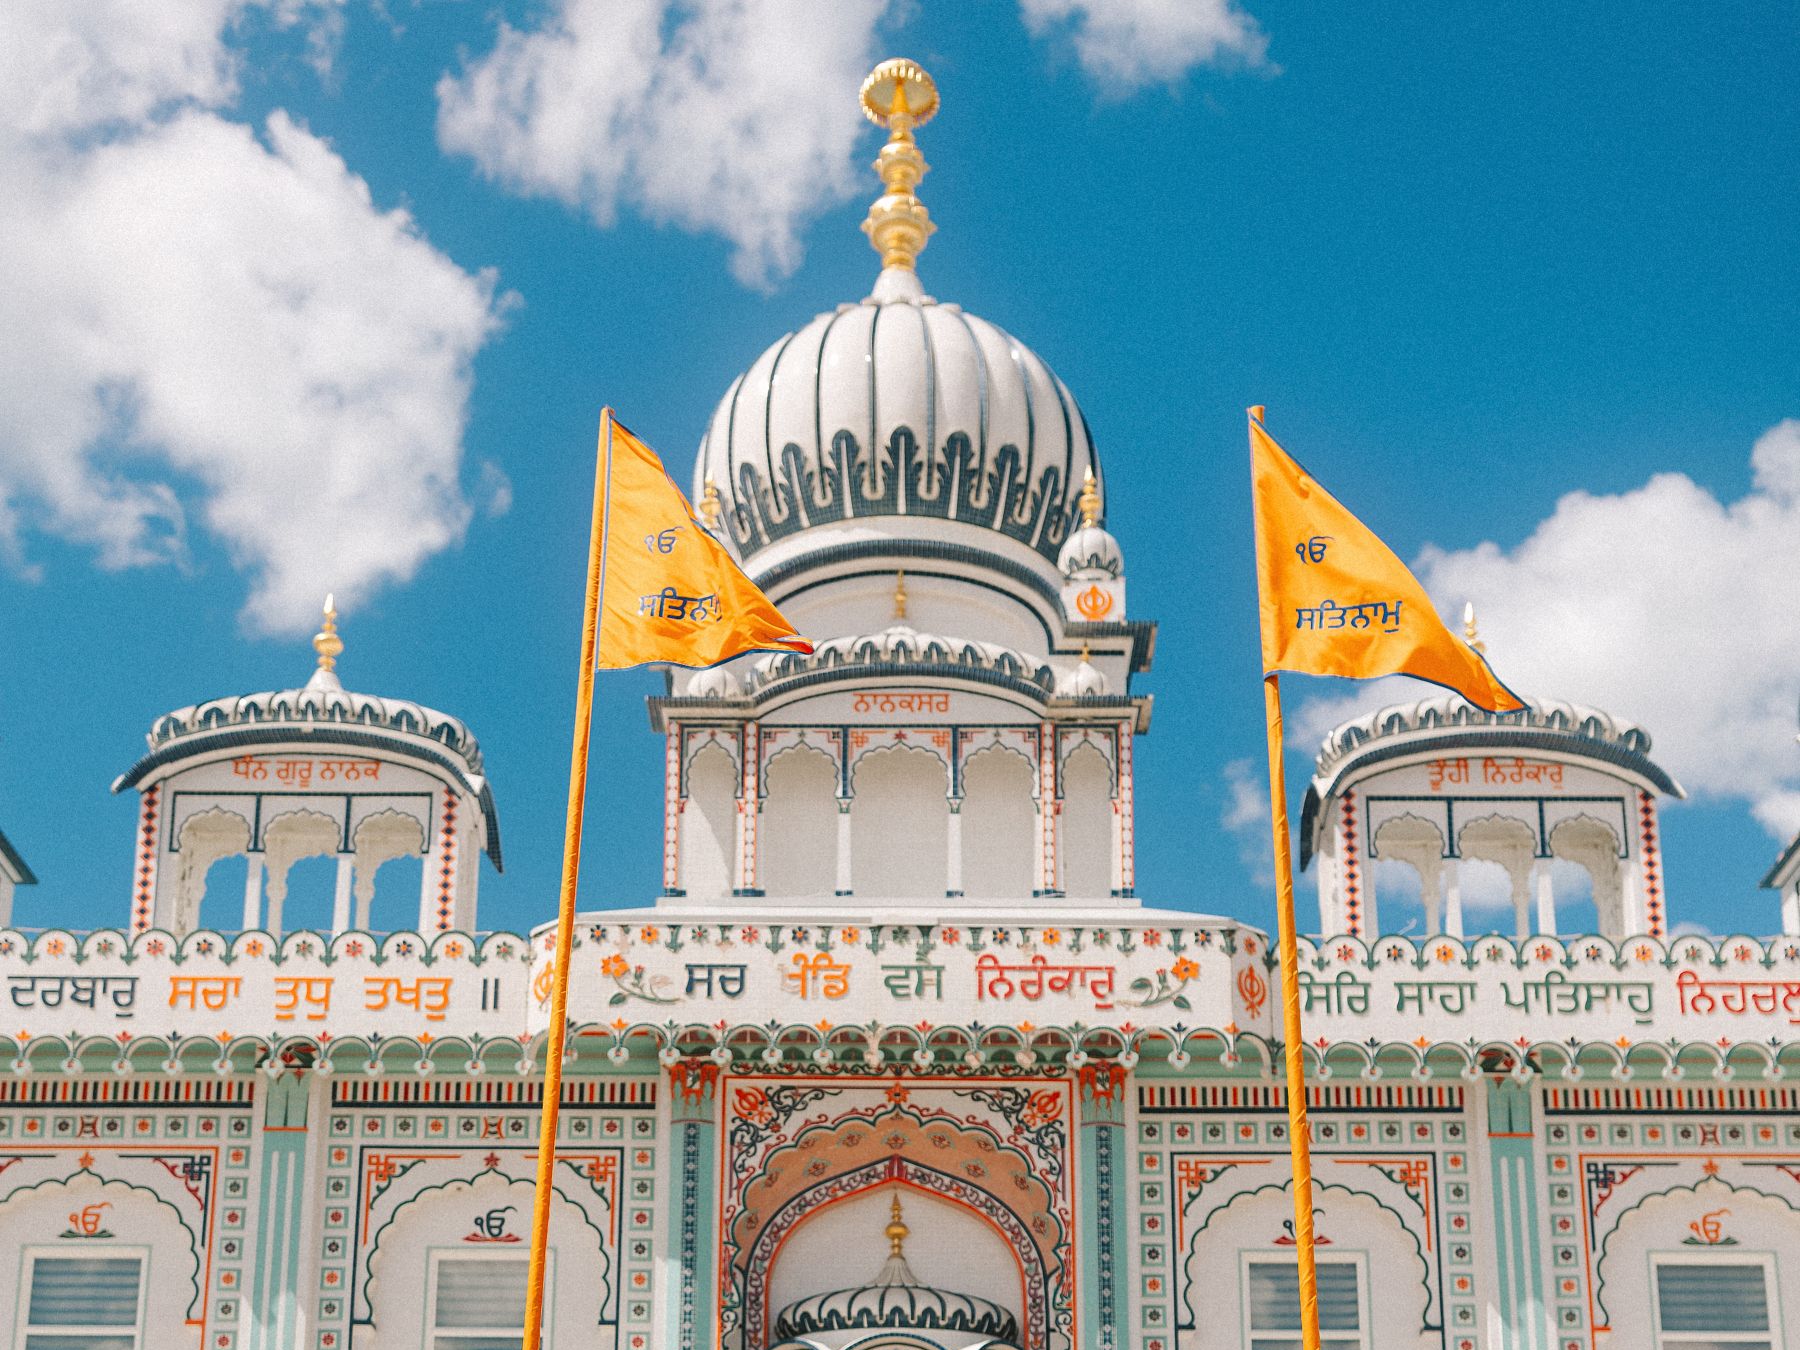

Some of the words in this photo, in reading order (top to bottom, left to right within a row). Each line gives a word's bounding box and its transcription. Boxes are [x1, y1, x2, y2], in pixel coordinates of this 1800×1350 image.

[1295, 600, 1402, 632] ਸਤਿਨਾਮੁ
[853, 693, 949, 712] ਨਾਨਕਸਰ
[276, 760, 313, 787] ਗੁਰੂ
[320, 760, 381, 781] ਨਾਨਕ
[8, 976, 139, 1018] ਦਰਬਾਰੁ
[364, 977, 453, 1021] ਤਖਤੁ
[685, 964, 747, 997] ਸਚ
[975, 954, 1115, 1009] ਨਿਰੰਕਾਰੁ
[1394, 981, 1477, 1014] ਸਾਹਾ
[1500, 971, 1653, 1024] ਪਾਤਿਸਾਹੁ
